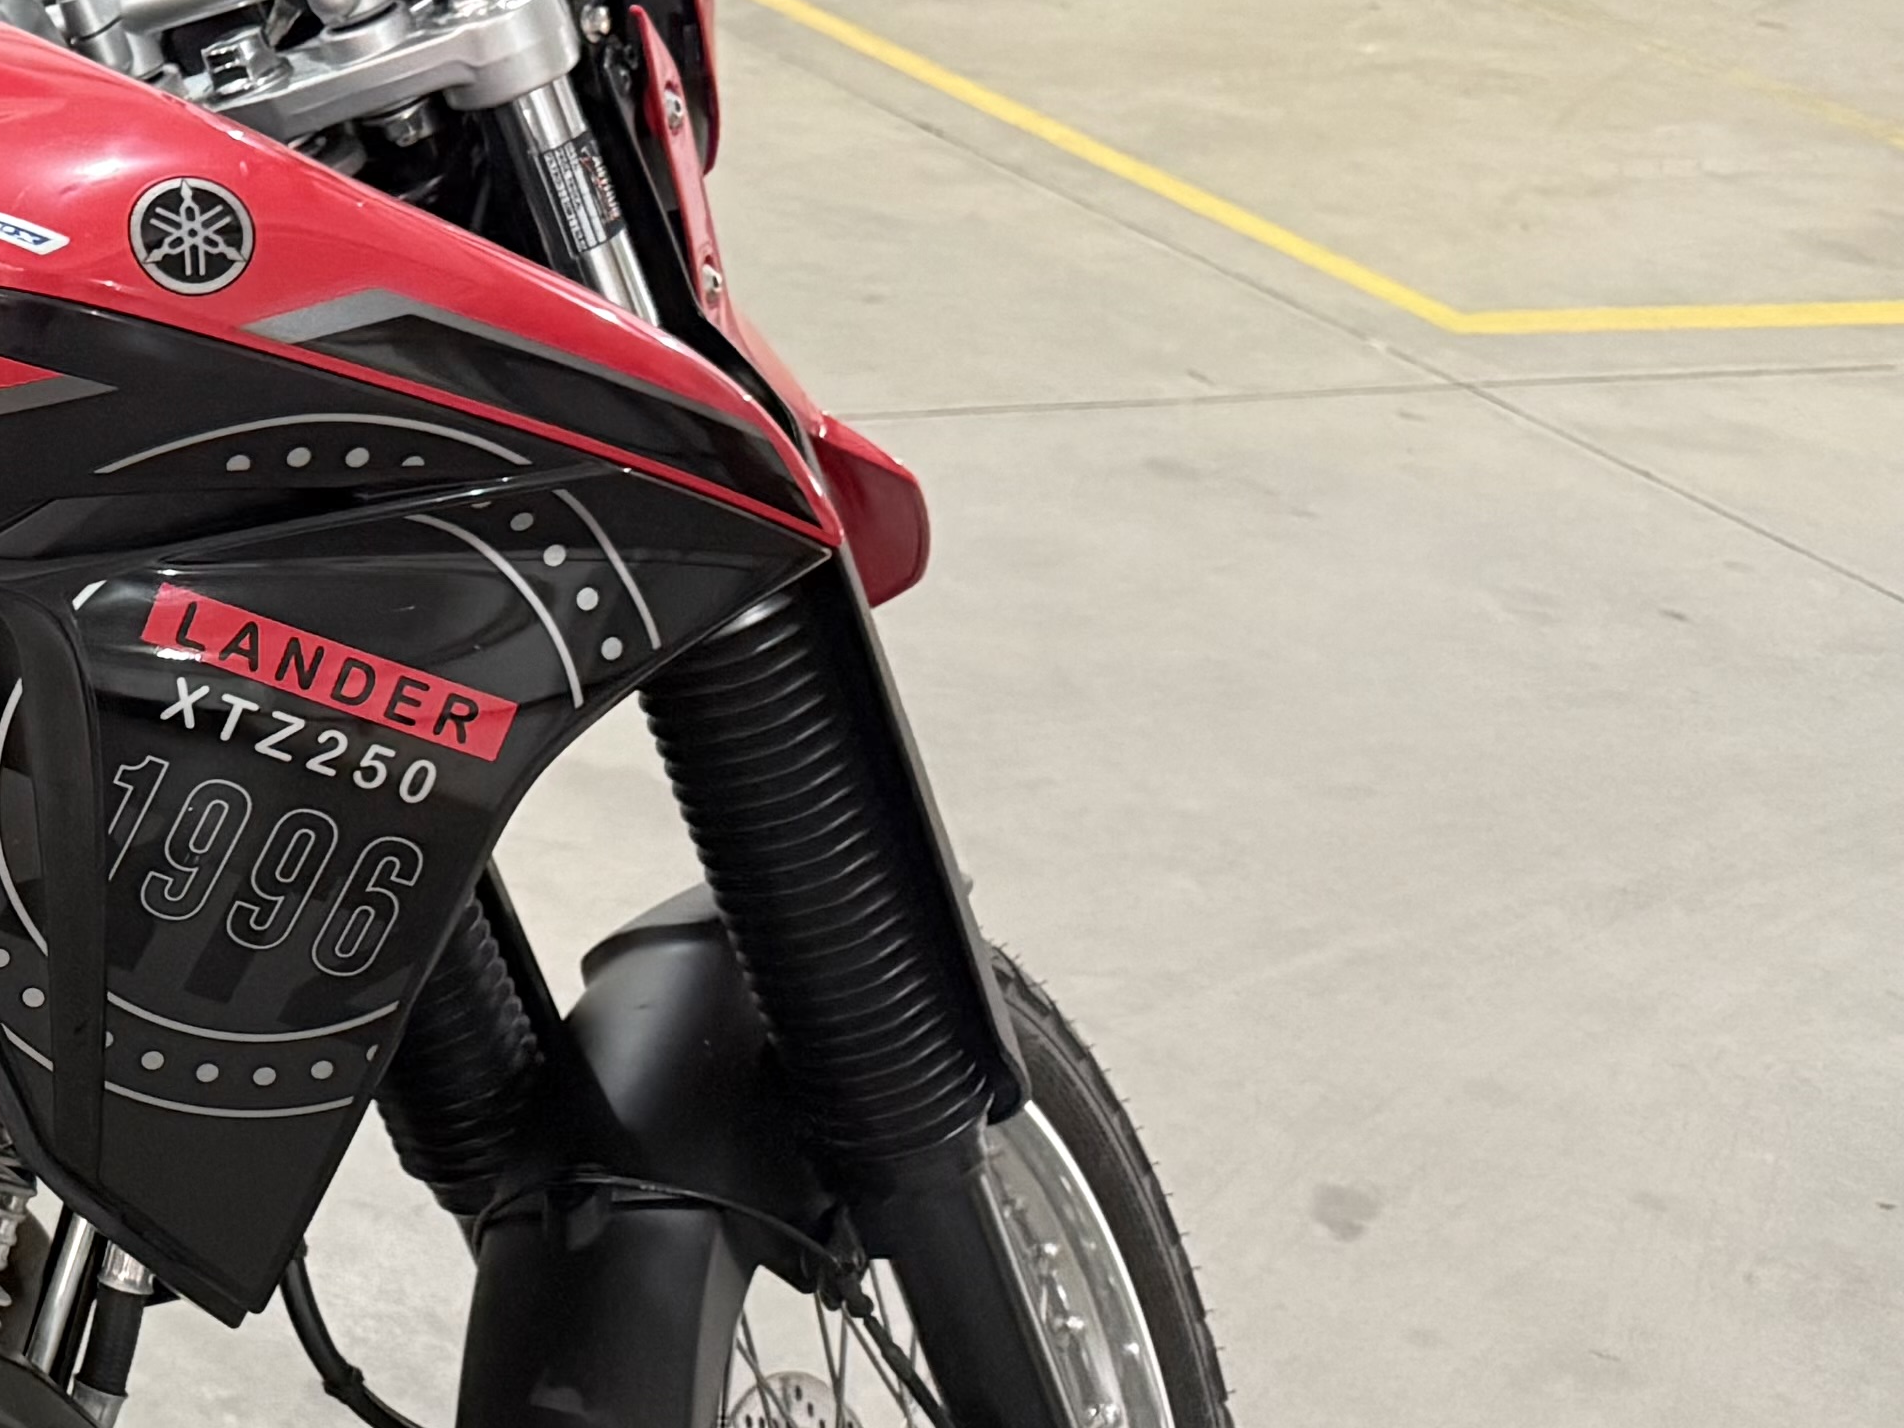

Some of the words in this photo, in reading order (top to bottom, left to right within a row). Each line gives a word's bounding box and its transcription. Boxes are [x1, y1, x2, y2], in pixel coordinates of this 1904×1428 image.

[159, 676, 438, 804] XTZ250
[174, 601, 480, 744] LANDER
[107, 754, 425, 977] 1996
